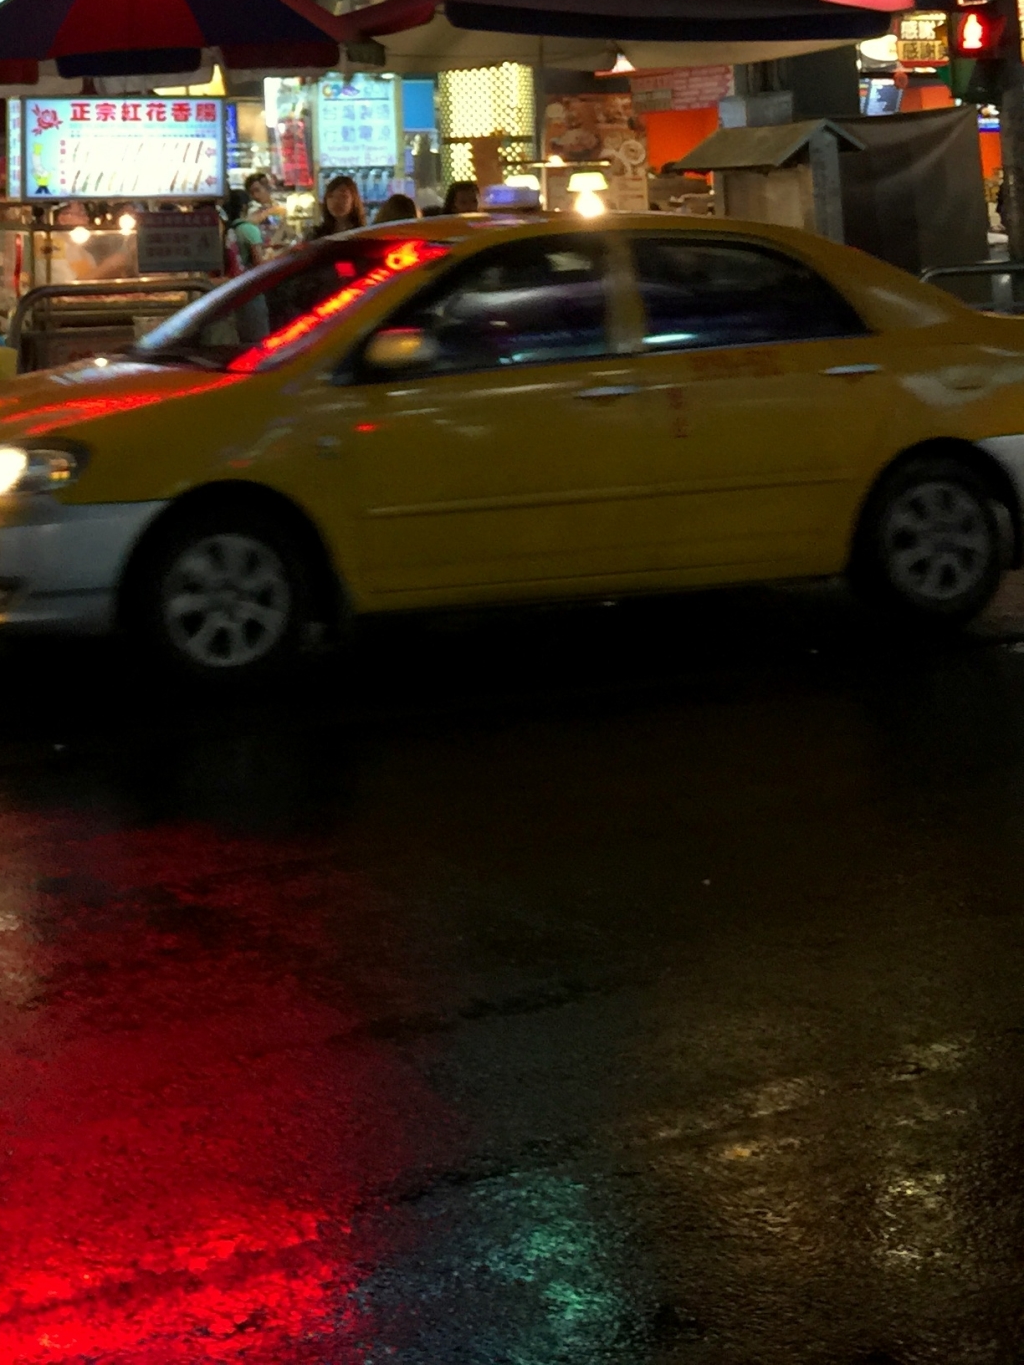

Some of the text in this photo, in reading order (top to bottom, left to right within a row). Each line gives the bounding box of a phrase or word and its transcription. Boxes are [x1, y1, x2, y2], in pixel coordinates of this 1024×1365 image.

[70, 101, 218, 123] 正宗紅花香腸
